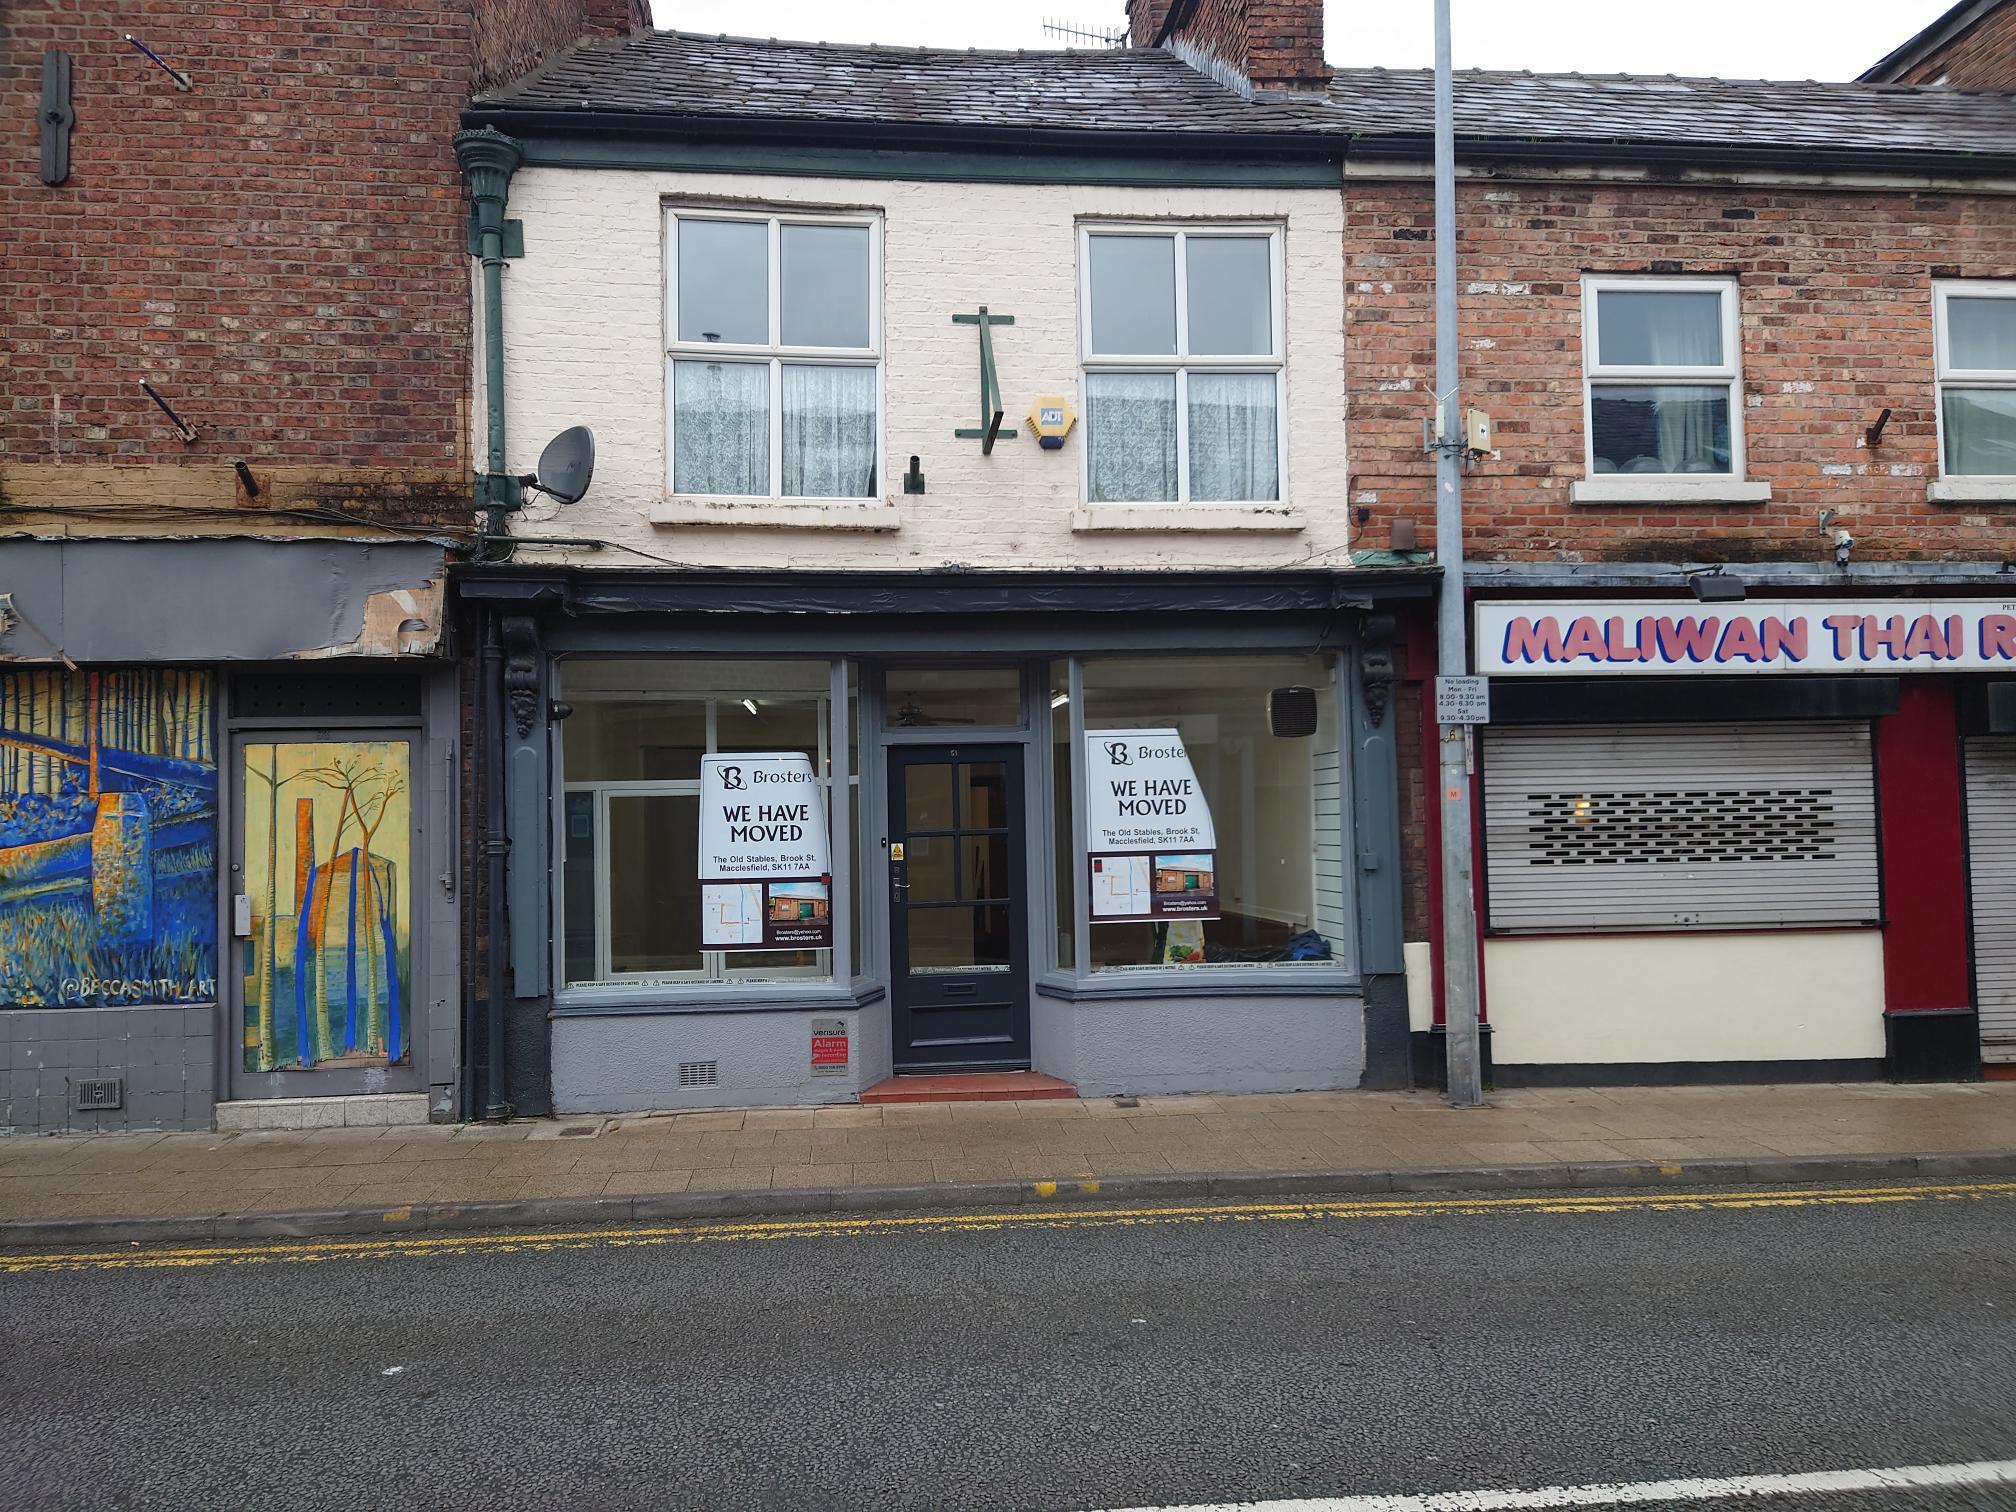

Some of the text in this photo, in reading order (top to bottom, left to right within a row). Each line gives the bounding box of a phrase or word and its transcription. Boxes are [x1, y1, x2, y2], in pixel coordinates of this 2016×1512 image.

[1041, 410, 1063, 422] ADT
[1501, 615, 1808, 664] MALIWAN
[1822, 614, 1964, 661] THAI
[1456, 678, 1479, 686] loading
[1449, 729, 1456, 741] 6
[753, 770, 812, 784] Brosters
[1110, 779, 1193, 797] WE HAVE
[723, 804, 810, 822] WE HAVE
[1118, 799, 1187, 816] MOVED
[731, 824, 803, 842] MOVED
[1102, 829, 1116, 837] The
[1133, 828, 1163, 836] Stables,
[1166, 827, 1188, 835] Brook
[1108, 837, 1156, 845] Macclesfield,
[1157, 836, 1177, 844] SK11
[713, 855, 728, 864] The
[730, 855, 744, 863] Old
[746, 855, 778, 863] Stables,
[780, 854, 804, 862] Brook
[719, 863, 811, 872] Macclesfield, SK11 7AA
[61, 977, 217, 1000] @BECCASMITH_ART
[814, 1038, 847, 1048] Alarm
